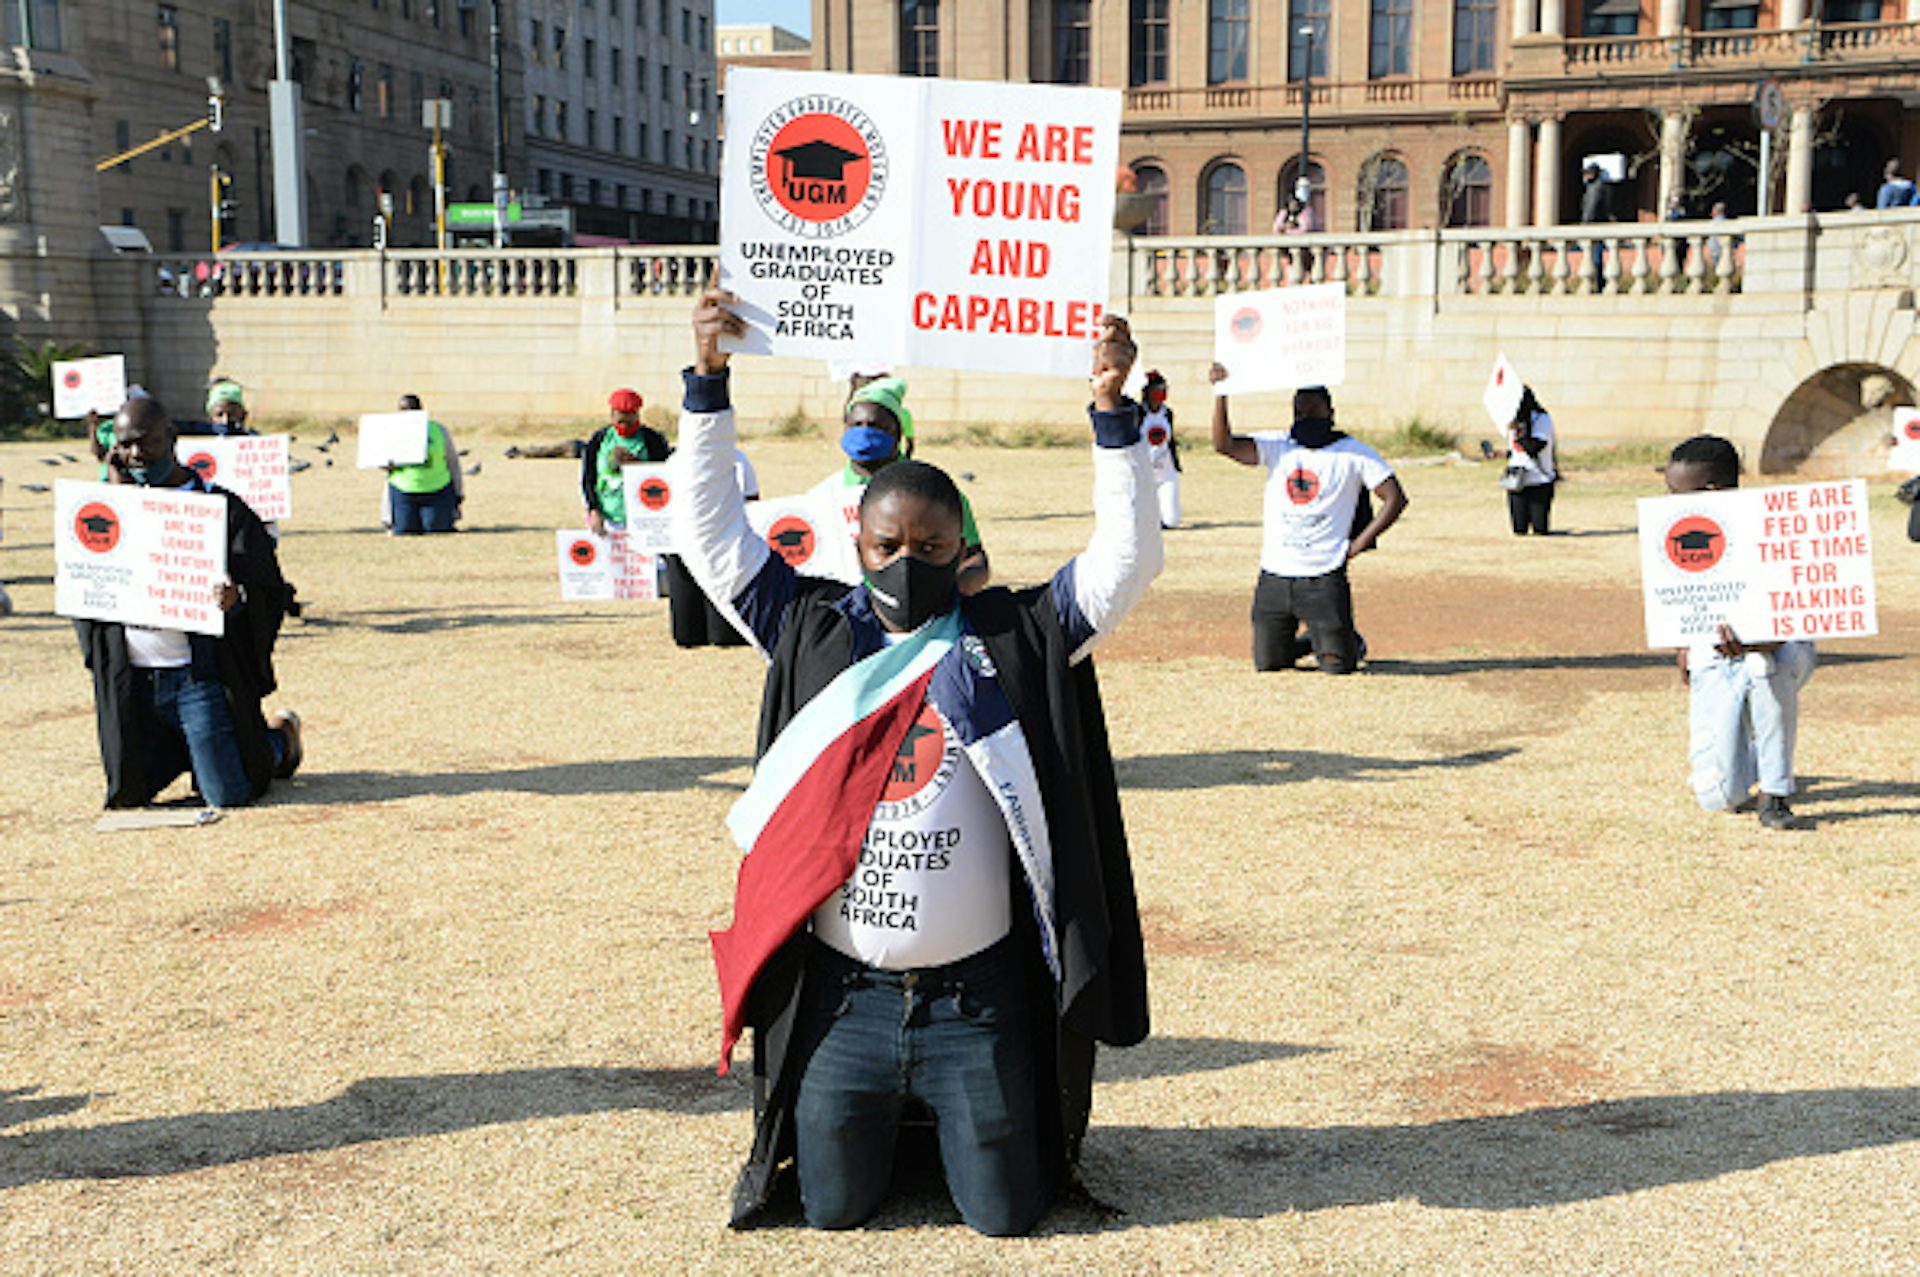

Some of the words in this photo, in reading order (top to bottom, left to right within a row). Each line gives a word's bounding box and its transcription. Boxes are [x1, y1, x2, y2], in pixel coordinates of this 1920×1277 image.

[941, 119, 1002, 158] WE
[1016, 123, 1094, 164] ARE
[788, 181, 847, 204] UGM
[947, 178, 1081, 223] YOUNG
[741, 243, 895, 267] UNEMPLOYED
[970, 239, 1051, 277] AND
[750, 262, 883, 285] GRADUATES
[802, 284, 831, 301] OF
[778, 301, 854, 320] SOUTH
[912, 291, 1103, 339] CAPABLE!
[776, 320, 854, 340] AFRICA
[1764, 491, 1798, 511] WE
[1809, 485, 1853, 508] ARE
[1764, 514, 1807, 537] FED
[1816, 510, 1856, 534] UP!
[1757, 540, 1801, 562] THE
[1810, 534, 1868, 559] TIME
[1792, 562, 1837, 585] FOR
[1768, 585, 1865, 612] TALKING
[1773, 616, 1794, 637] IS
[1803, 611, 1865, 634] OVER
[865, 828, 961, 850] PLOYED
[859, 848, 952, 871] DUATES
[863, 869, 894, 889] OF
[840, 882, 919, 912] SOUTH
[840, 901, 917, 931] AFRICA
